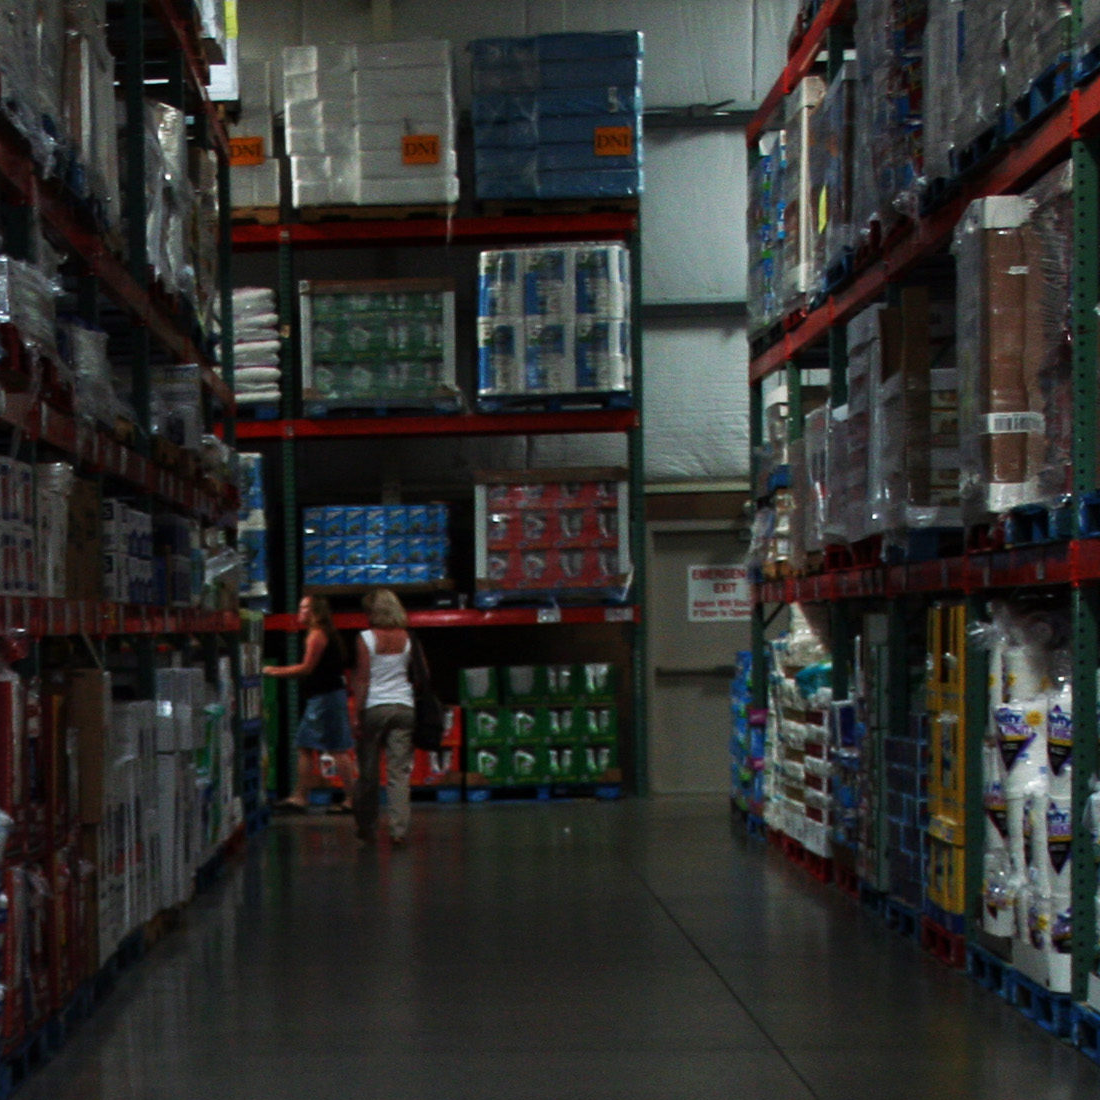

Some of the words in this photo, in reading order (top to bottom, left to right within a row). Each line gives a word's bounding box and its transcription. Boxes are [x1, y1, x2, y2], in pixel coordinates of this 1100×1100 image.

[597, 134, 629, 149] DNI
[405, 142, 437, 156] DNI
[713, 583, 736, 593] EXIT
